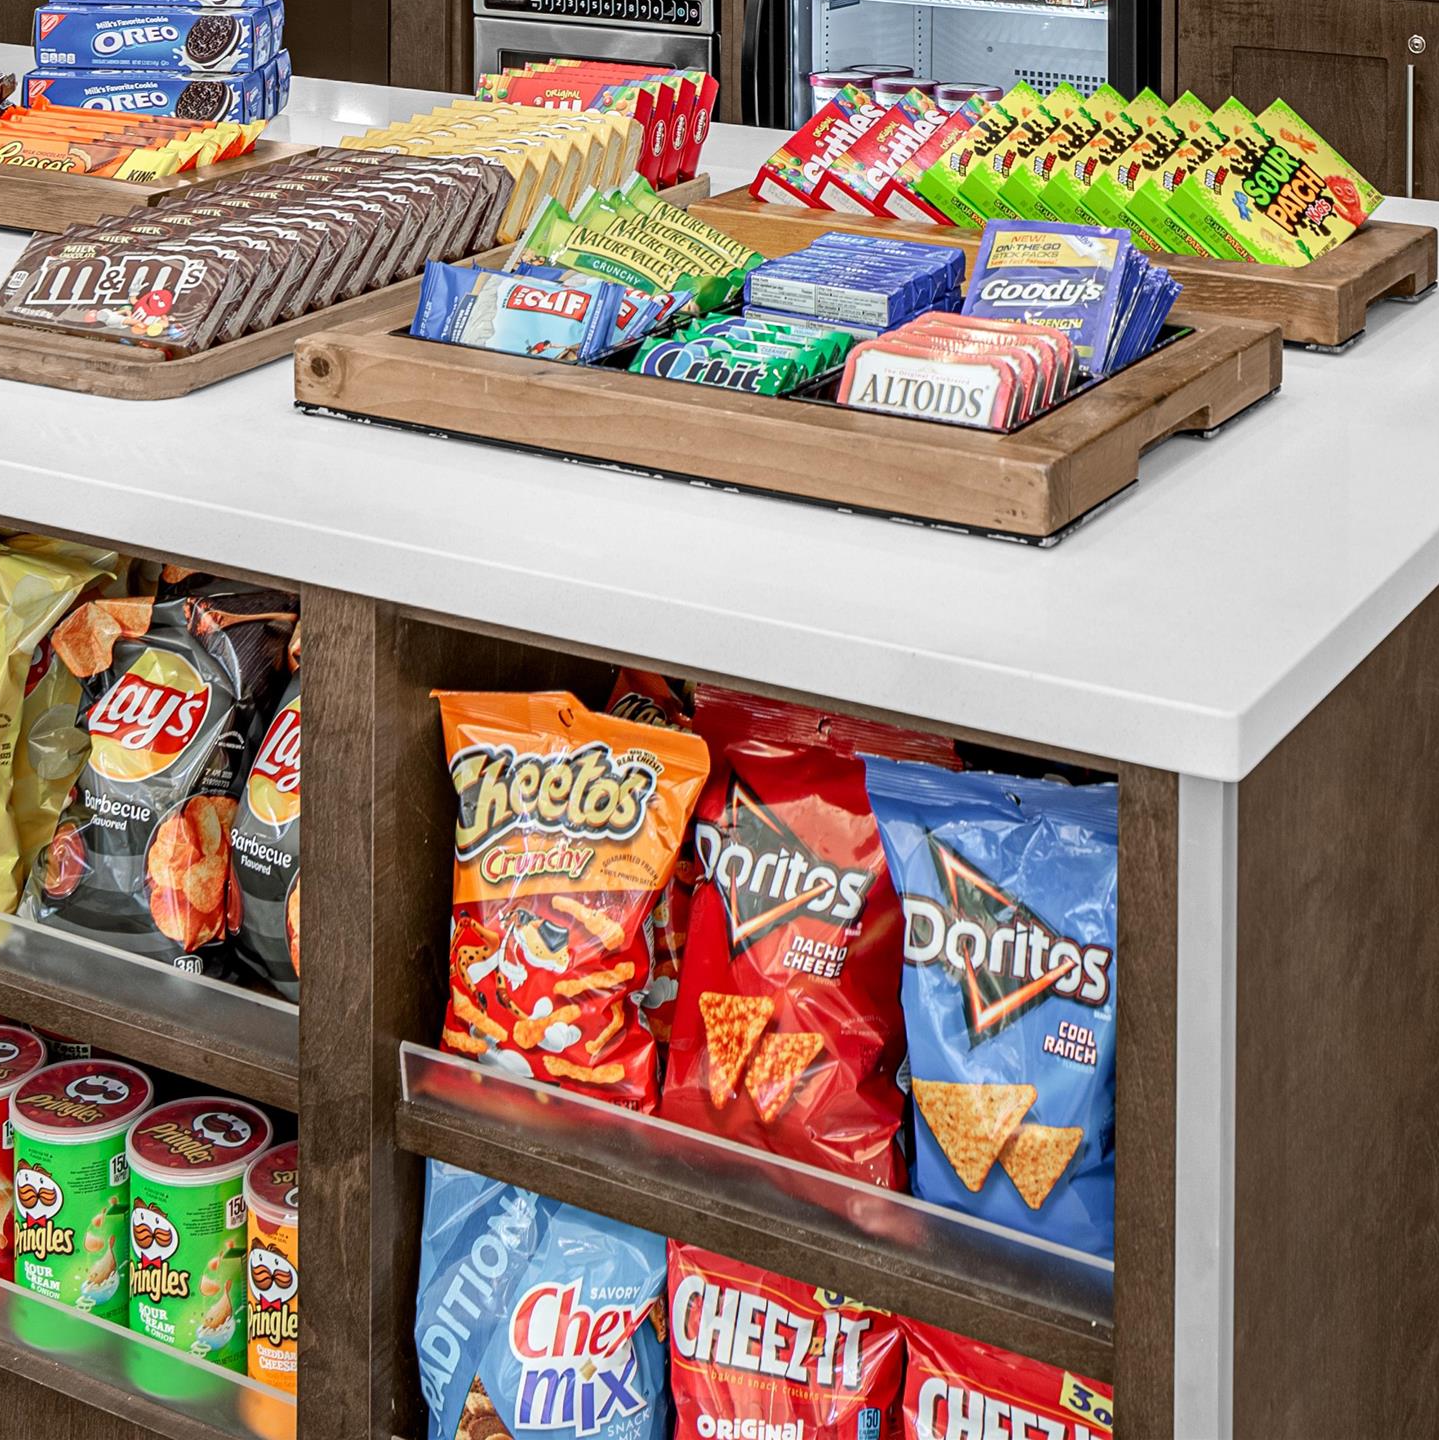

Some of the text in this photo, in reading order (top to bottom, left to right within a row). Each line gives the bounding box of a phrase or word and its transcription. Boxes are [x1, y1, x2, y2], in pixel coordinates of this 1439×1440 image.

[580, 0, 585, 8] 4
[654, 6, 659, 14] 0
[1244, 146, 1300, 205] SOUR
[1265, 165, 1326, 231] PATCH
[1306, 199, 1332, 225] Kids
[63, 245, 97, 254] MILK
[572, 227, 675, 285] NATURE VALLEY
[593, 261, 641, 285] CRUNCHY
[524, 289, 584, 314] CLIF
[981, 277, 1103, 306] Goody's
[858, 374, 984, 417] ALTOIDS
[89, 675, 204, 749] Lay's
[85, 790, 150, 821] Barbecue
[453, 748, 648, 850] Cheetos
[484, 843, 593, 879] Crunchy
[696, 823, 867, 919] Doritos
[792, 937, 847, 960] NACHO
[903, 900, 1108, 1001] Doritos
[783, 952, 843, 977] CHEESE
[1044, 1036, 1096, 1062] RANCH
[1059, 1023, 1095, 1045] COOL
[590, 1286, 640, 1300] SAVORY
[511, 1283, 651, 1358] Chex
[517, 1362, 648, 1437] mix
